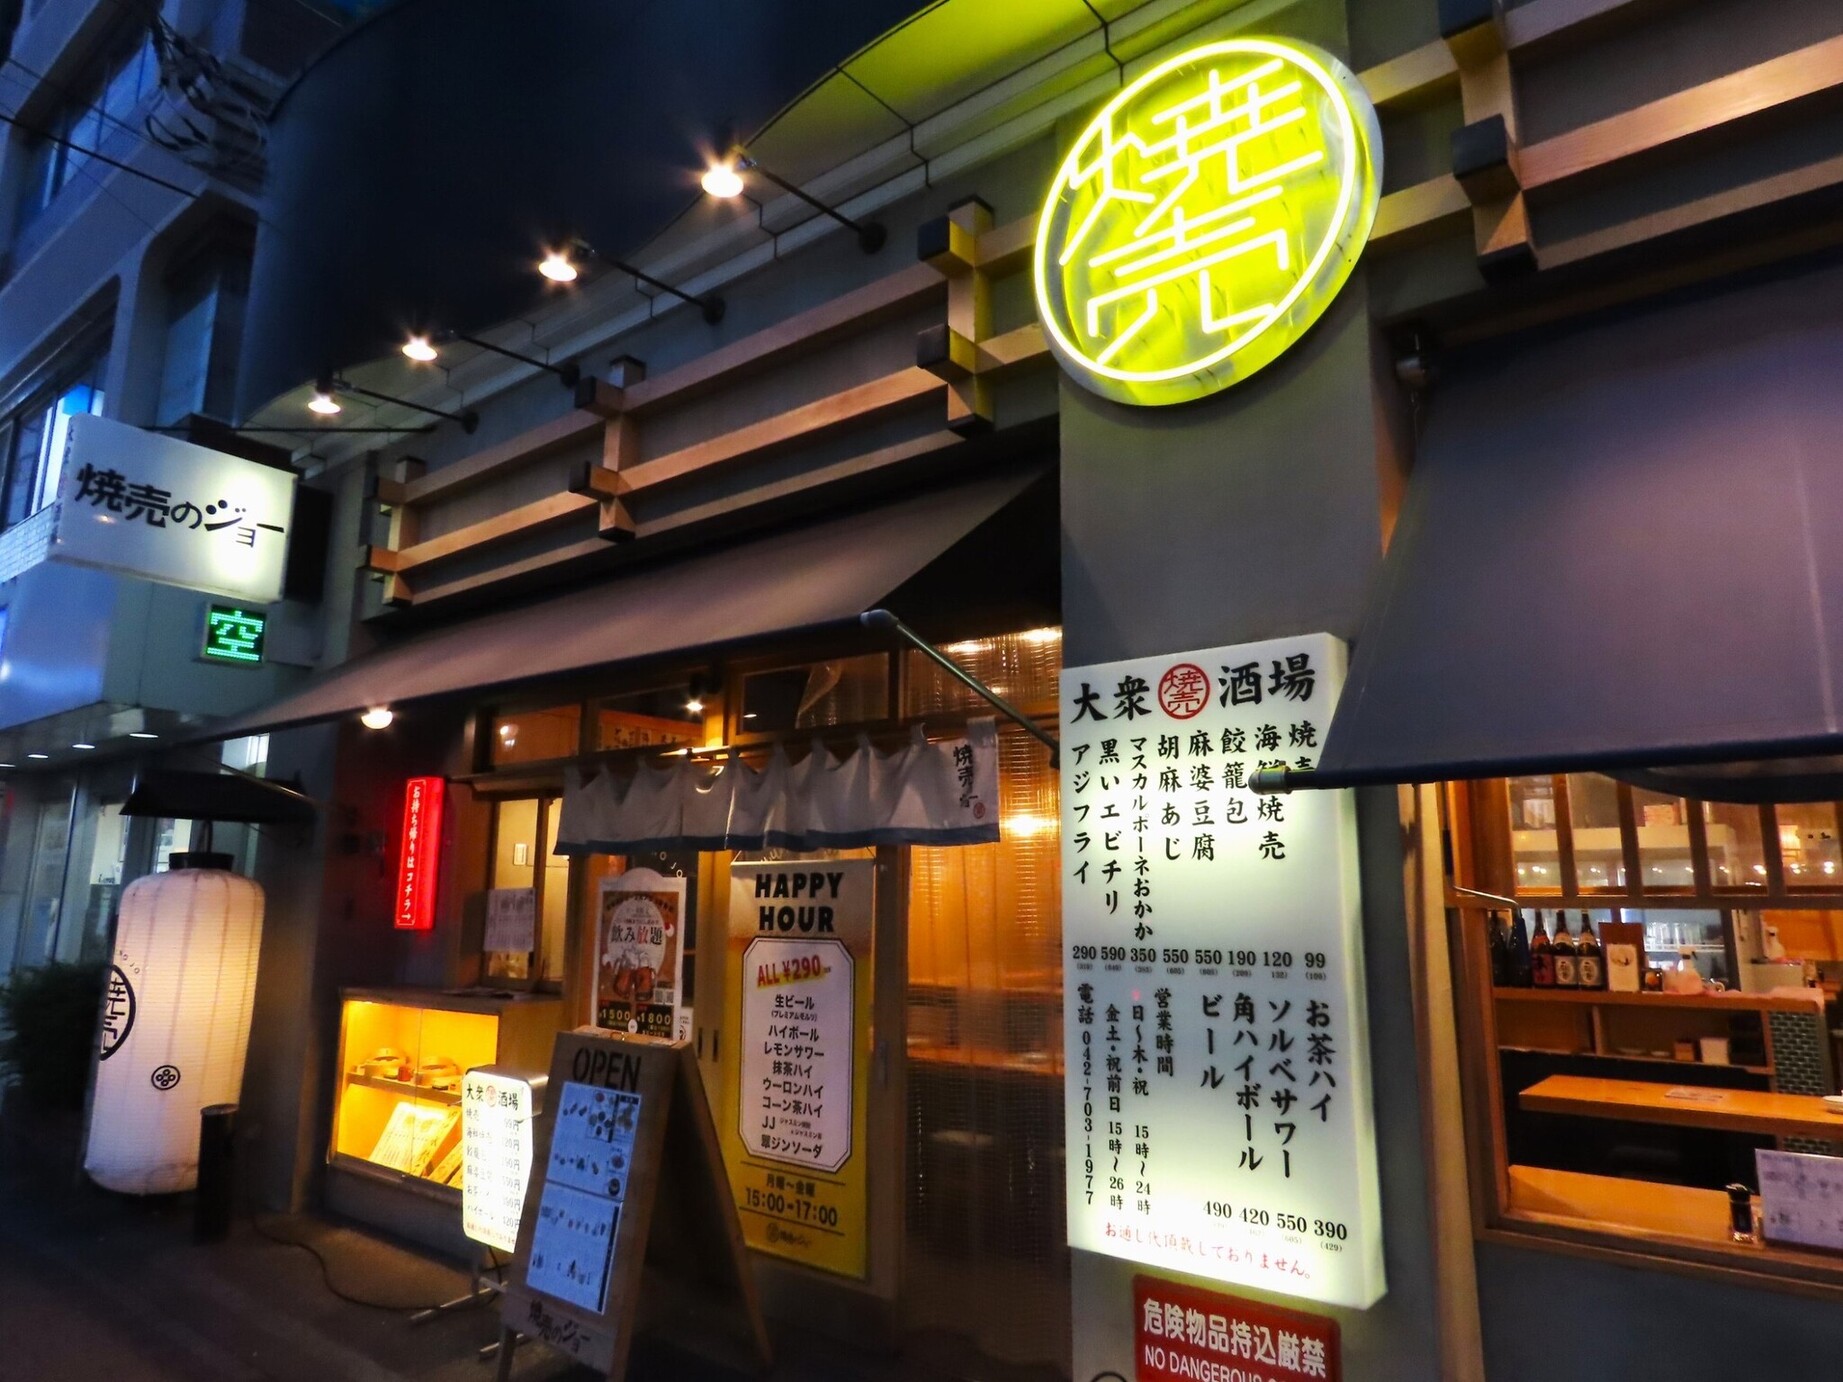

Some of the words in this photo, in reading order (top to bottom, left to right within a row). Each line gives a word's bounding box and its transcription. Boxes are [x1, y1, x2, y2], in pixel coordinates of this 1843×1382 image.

[75, 462, 285, 548] 焼売のジョー
[208, 610, 264, 662] 空
[1070, 675, 1152, 724] 大衆
[1163, 668, 1206, 716] 焼売
[1218, 653, 1315, 708] 酒場
[1188, 730, 1215, 861] 麻婆豆腐
[1220, 727, 1248, 824] 餃籠包
[1072, 743, 1091, 884] アジフライ
[1158, 735, 1182, 860] 胡麻あじ
[1099, 738, 1122, 914] 黒いエビチリ
[1130, 737, 1153, 941] マスカルポーネおかか
[755, 872, 844, 898] HAPPY
[611, 925, 663, 945] 飲み放題
[759, 906, 834, 932] HOUR
[757, 964, 780, 987] ALL
[782, 954, 821, 981] ¥290
[1073, 946, 1097, 960] 290
[1101, 947, 1126, 961] 590
[1131, 948, 1156, 962] 350
[1163, 949, 1189, 964] 550
[1195, 950, 1223, 965] 550
[1228, 951, 1256, 966] 190
[1263, 951, 1292, 967] 120
[1305, 953, 1326, 968] 99
[775, 994, 814, 1010] 生ビール
[1077, 983, 1094, 1024] 電話
[764, 1042, 824, 1059] レモンサワー
[768, 1025, 819, 1042] ハイボール
[1154, 988, 1174, 1077] 営業時間
[1200, 994, 1225, 1089] ビール
[572, 1047, 642, 1093] OPEN
[773, 1060, 813, 1078] 抹茶ハイ
[1233, 992, 1263, 1171] 角ハイボール
[1306, 1000, 1336, 1122] お茶ハイ
[466, 1083, 484, 1102] 大衆
[762, 1078, 824, 1099] ウーロンハイ
[762, 1096, 824, 1118] コーン茶ハイ
[1268, 1000, 1298, 1178] ソルベサワー
[762, 1116, 775, 1129] JJ
[1082, 1031, 1094, 1205] 042-703-1977
[746, 1188, 837, 1227] 15:00-17:00
[1203, 1200, 1232, 1218] 490
[1238, 1207, 1269, 1226] 420
[1277, 1213, 1307, 1233] 550
[1314, 1219, 1347, 1240] 390
[1320, 1242, 1343, 1253] (429)
[1144, 1297, 1326, 1379] 危険物品持込厳禁
[1145, 1344, 1166, 1370] NO
